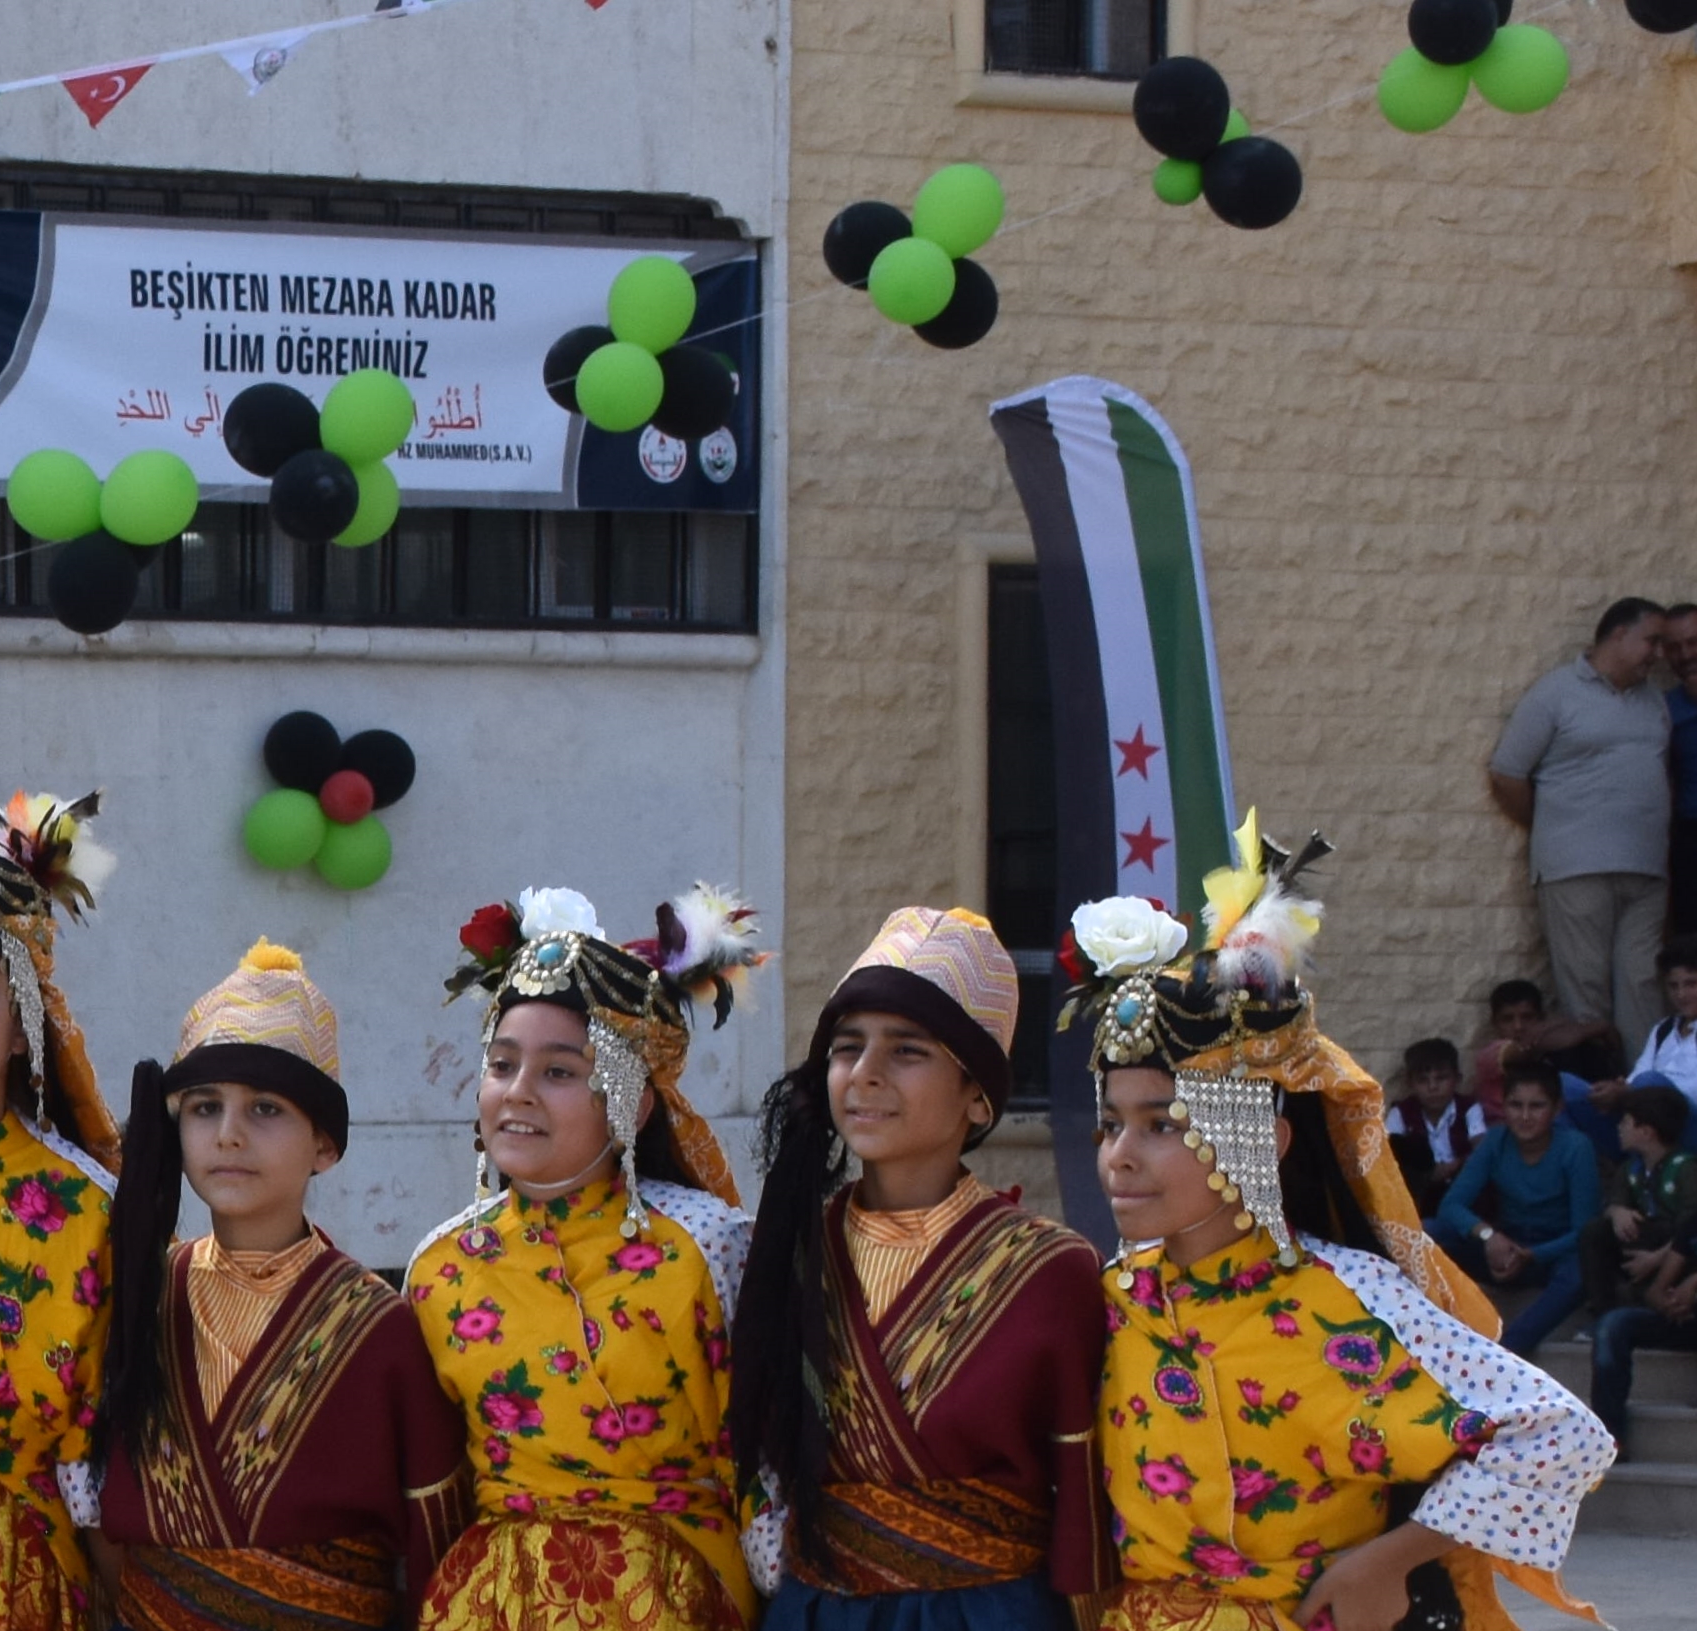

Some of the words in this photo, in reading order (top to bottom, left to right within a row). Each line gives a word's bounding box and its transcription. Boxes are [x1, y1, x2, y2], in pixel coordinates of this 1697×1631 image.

[131, 261, 269, 321] BEŞİKTEN
[281, 275, 394, 317] MEZARA
[404, 279, 497, 321] KADAR
[204, 323, 264, 373] İLİM
[276, 325, 429, 378] ÖĞRENİNİZ
